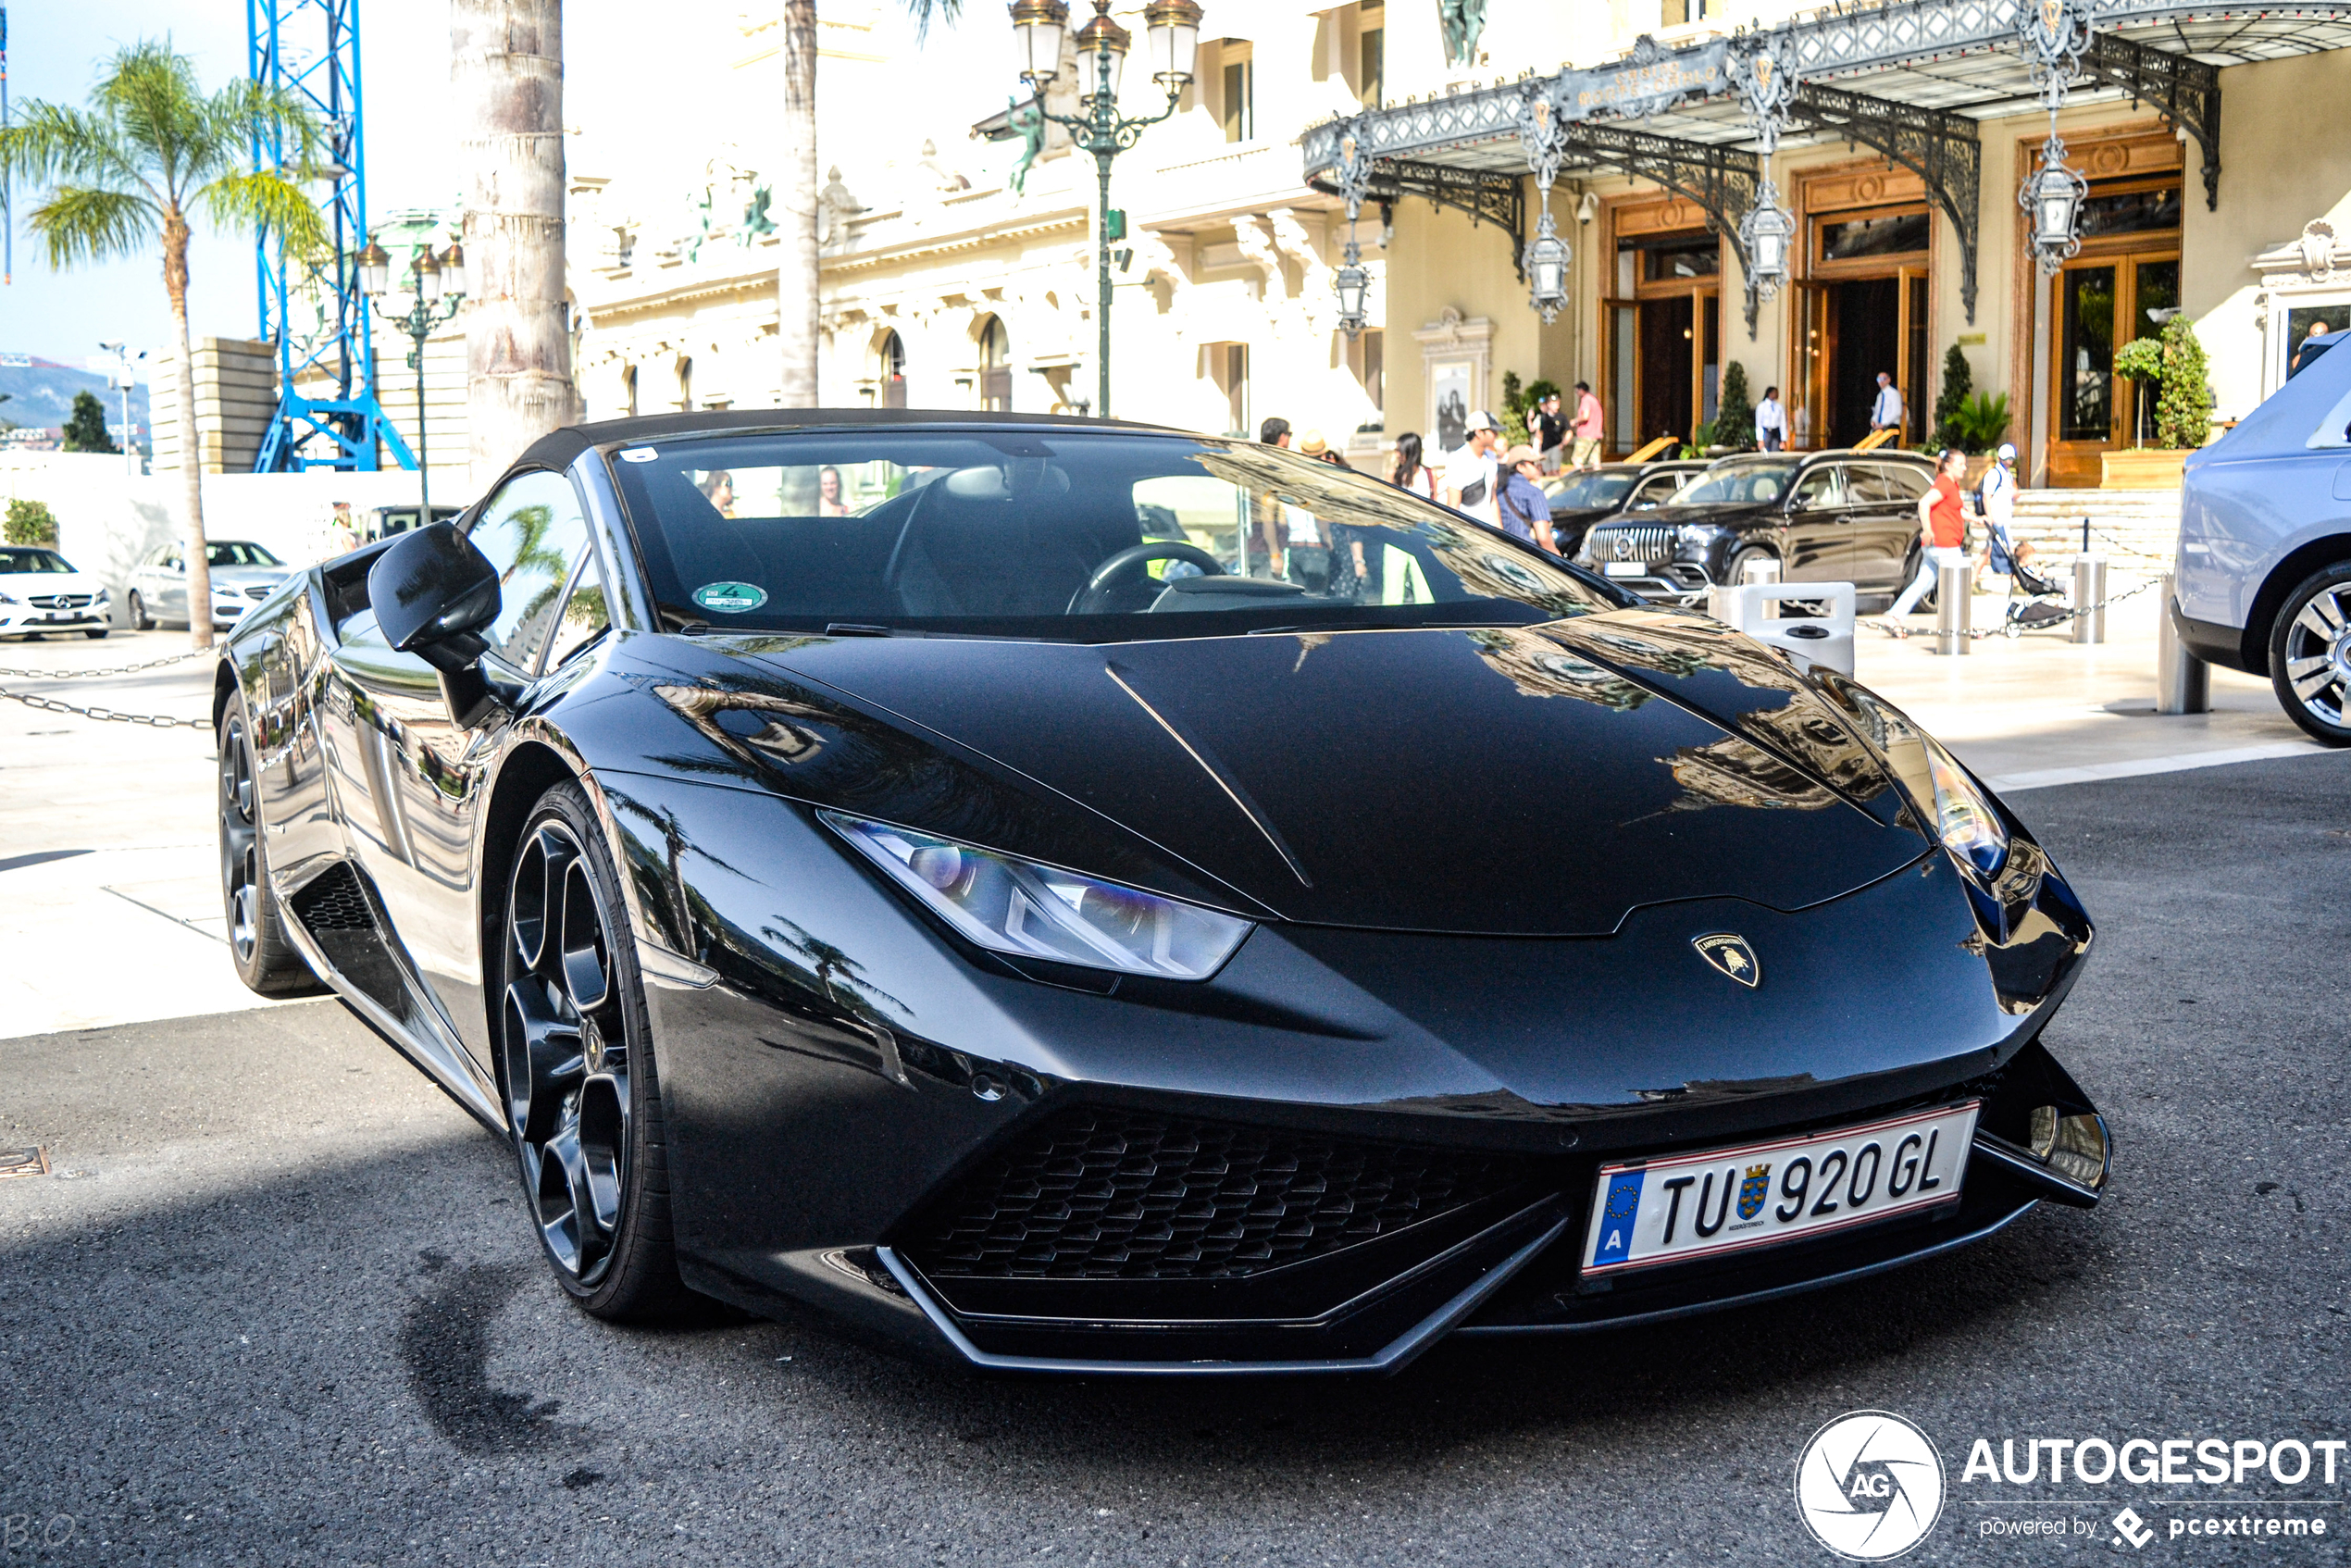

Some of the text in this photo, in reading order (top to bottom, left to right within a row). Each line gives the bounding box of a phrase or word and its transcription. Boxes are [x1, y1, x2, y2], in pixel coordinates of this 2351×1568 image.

[1615, 61, 1680, 86] CASINO
[721, 585, 740, 598] 4
[1604, 1127, 1940, 1251] A TU 920 GL
